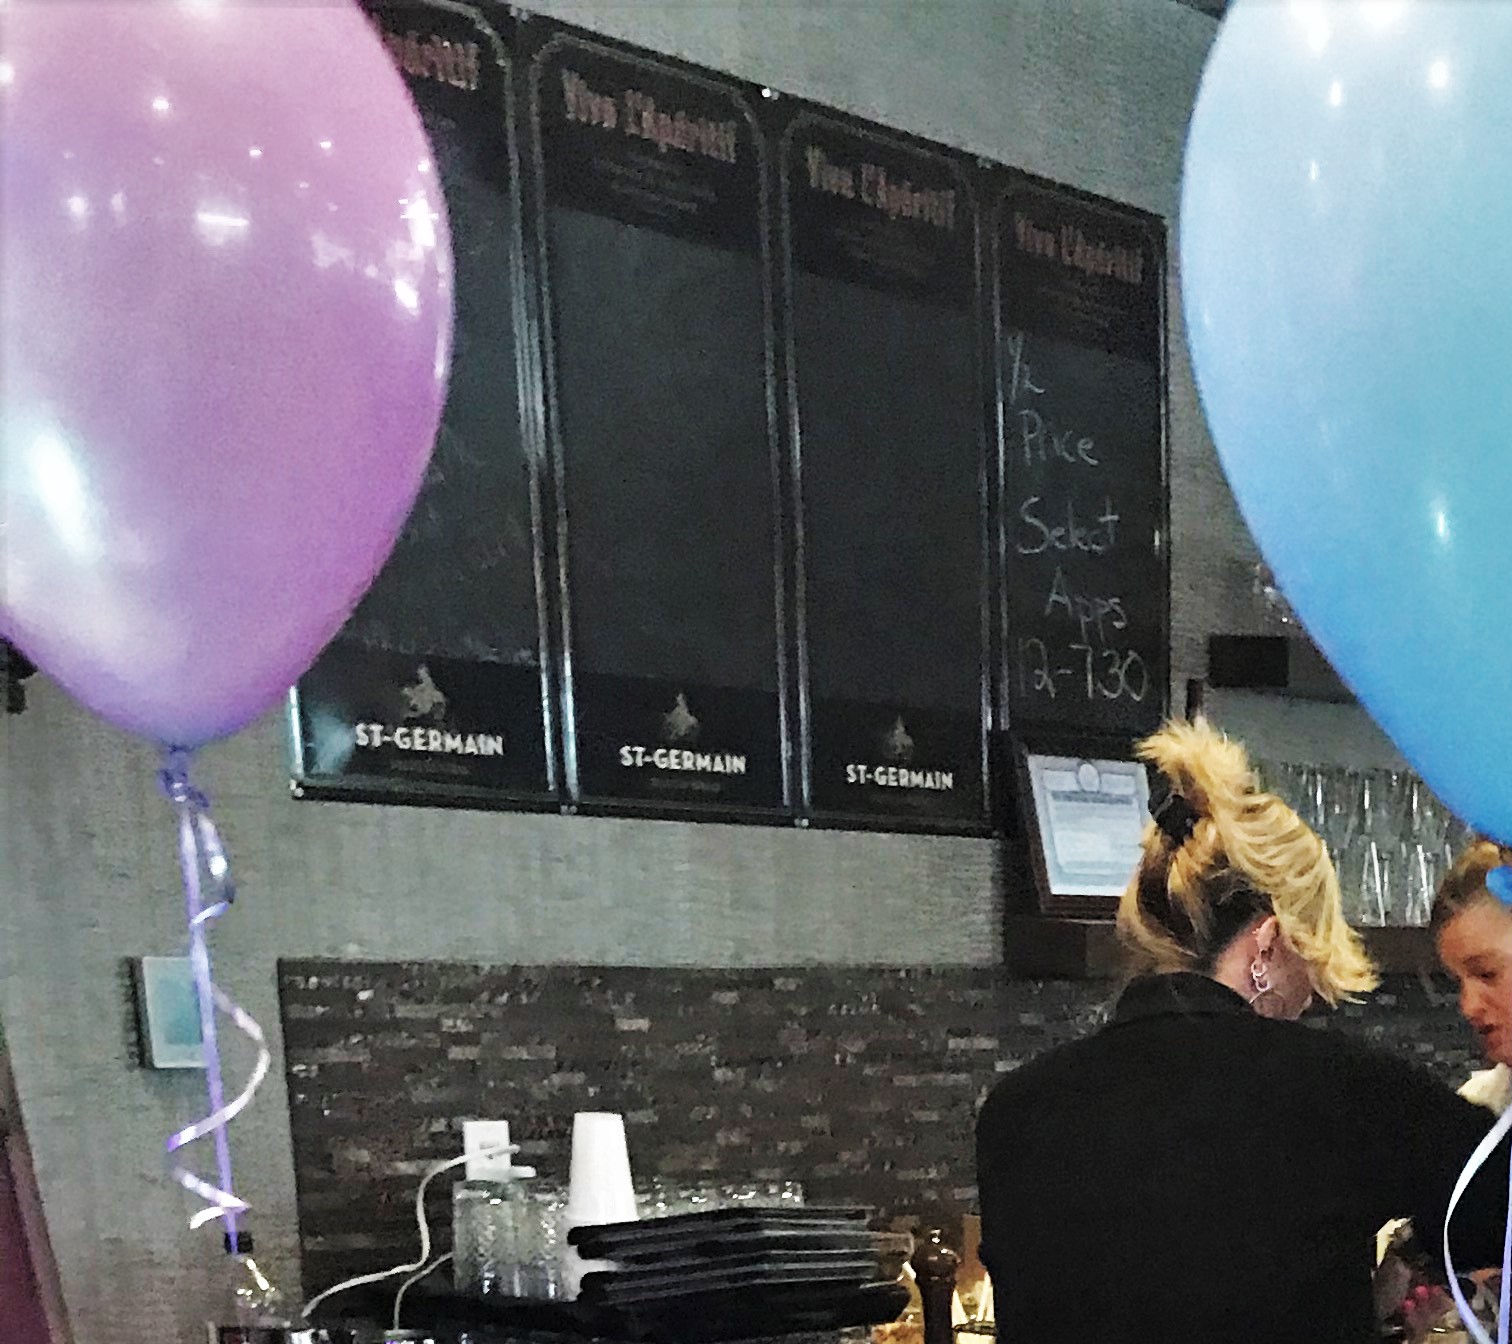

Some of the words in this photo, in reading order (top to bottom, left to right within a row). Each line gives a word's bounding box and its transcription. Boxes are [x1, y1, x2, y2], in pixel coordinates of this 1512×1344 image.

[1018, 408, 1098, 466] Price
[1018, 495, 1119, 554] Select
[1044, 565, 1128, 644] Apps
[354, 722, 504, 756] ST-GERMAIN
[618, 745, 747, 774] ST-GERMAIN
[845, 764, 954, 790] ST-GERMAIN
